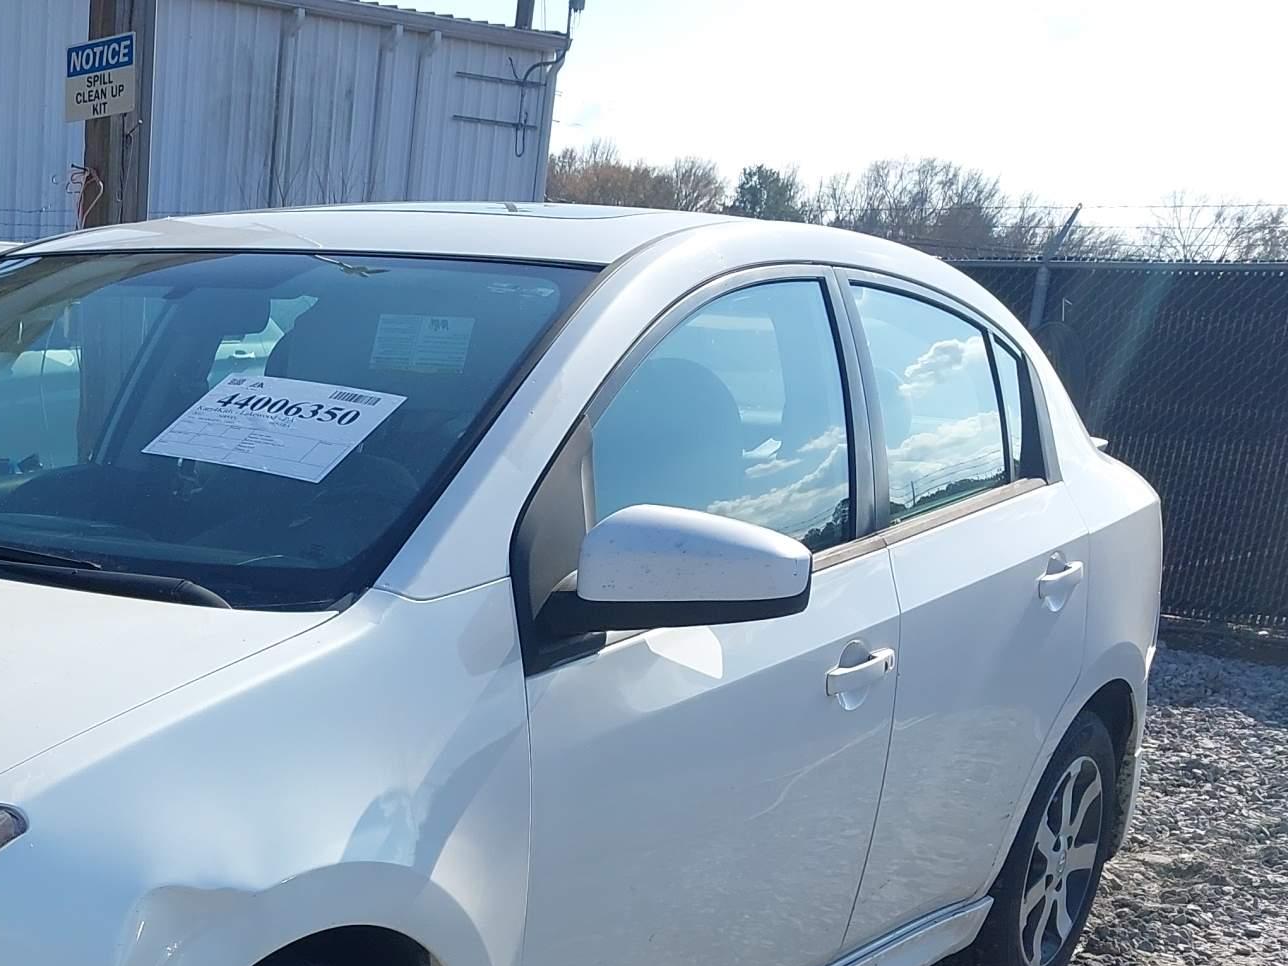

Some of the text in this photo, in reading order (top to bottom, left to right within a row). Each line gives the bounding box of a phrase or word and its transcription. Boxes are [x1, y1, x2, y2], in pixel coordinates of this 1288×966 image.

[70, 39, 131, 73] NOTICE
[86, 71, 114, 88] SPILL
[75, 84, 125, 105] CLEAN UP
[92, 101, 108, 116] KIT
[216, 391, 362, 426] 44006350
